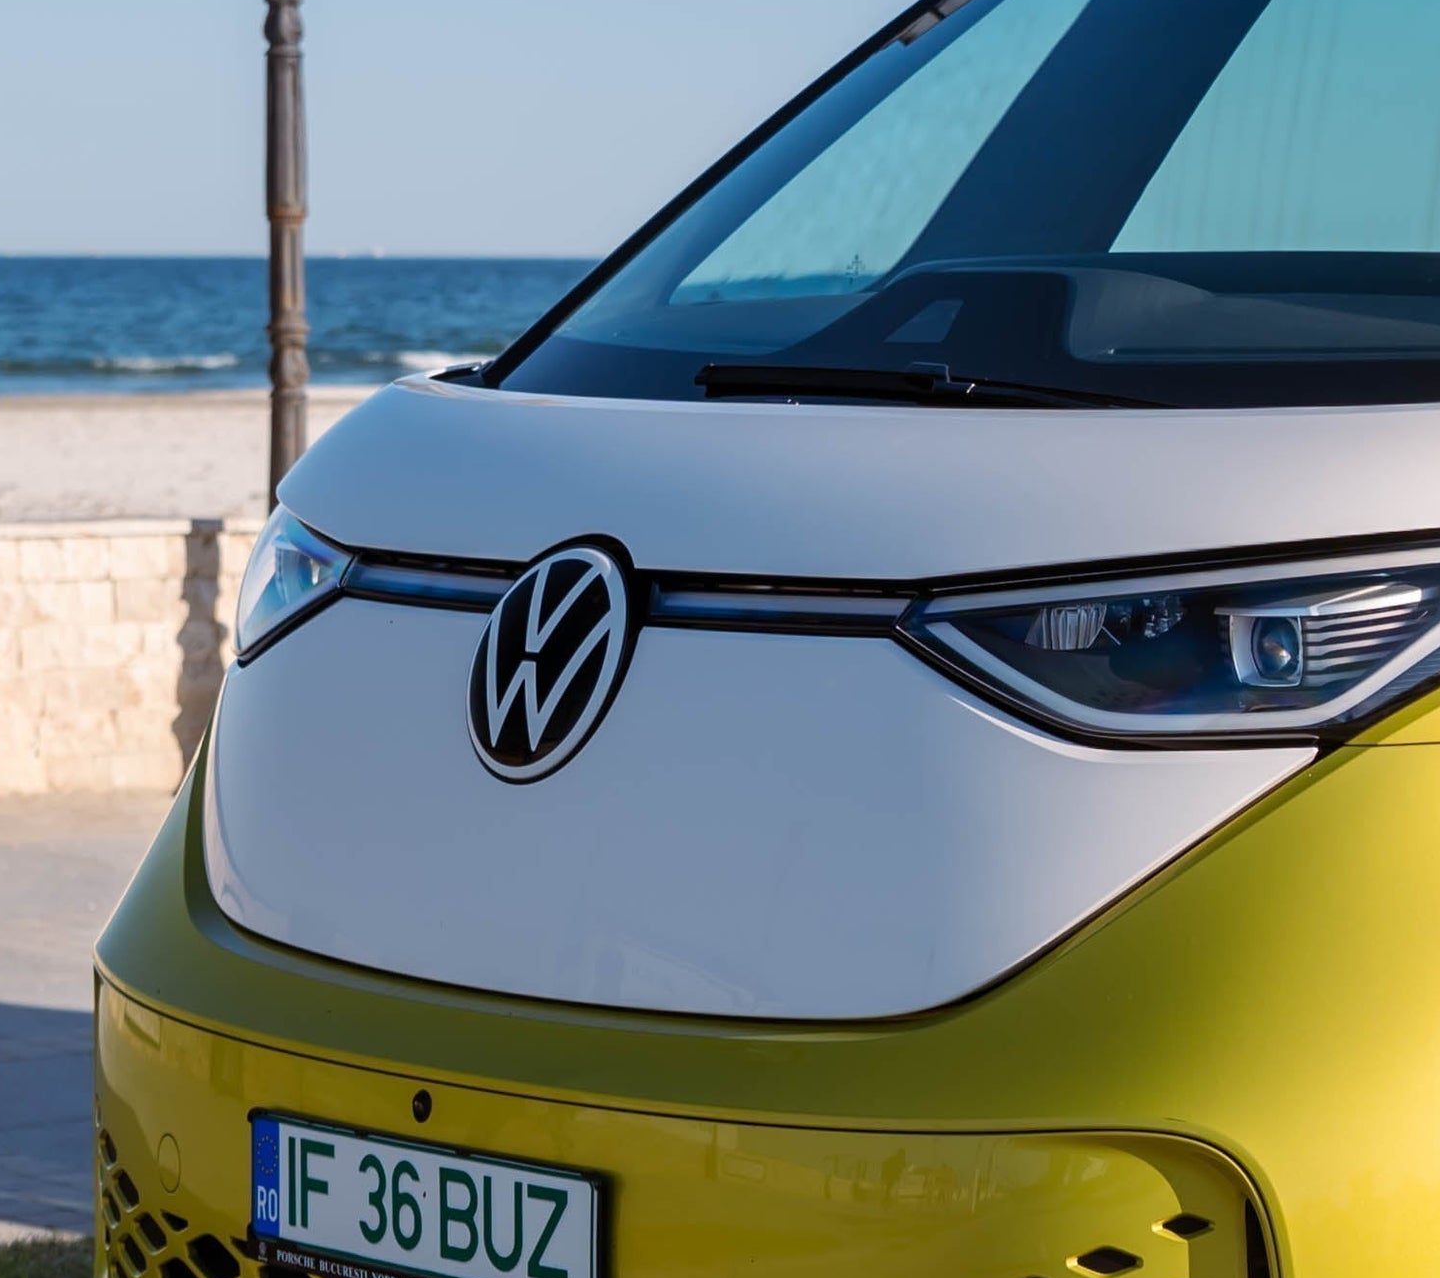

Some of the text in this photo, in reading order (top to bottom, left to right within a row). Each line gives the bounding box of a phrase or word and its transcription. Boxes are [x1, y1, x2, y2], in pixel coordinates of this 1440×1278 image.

[256, 1184, 278, 1223] RO
[287, 1136, 335, 1229] IF
[358, 1153, 423, 1251] 36
[276, 1249, 316, 1270] PORSCHE
